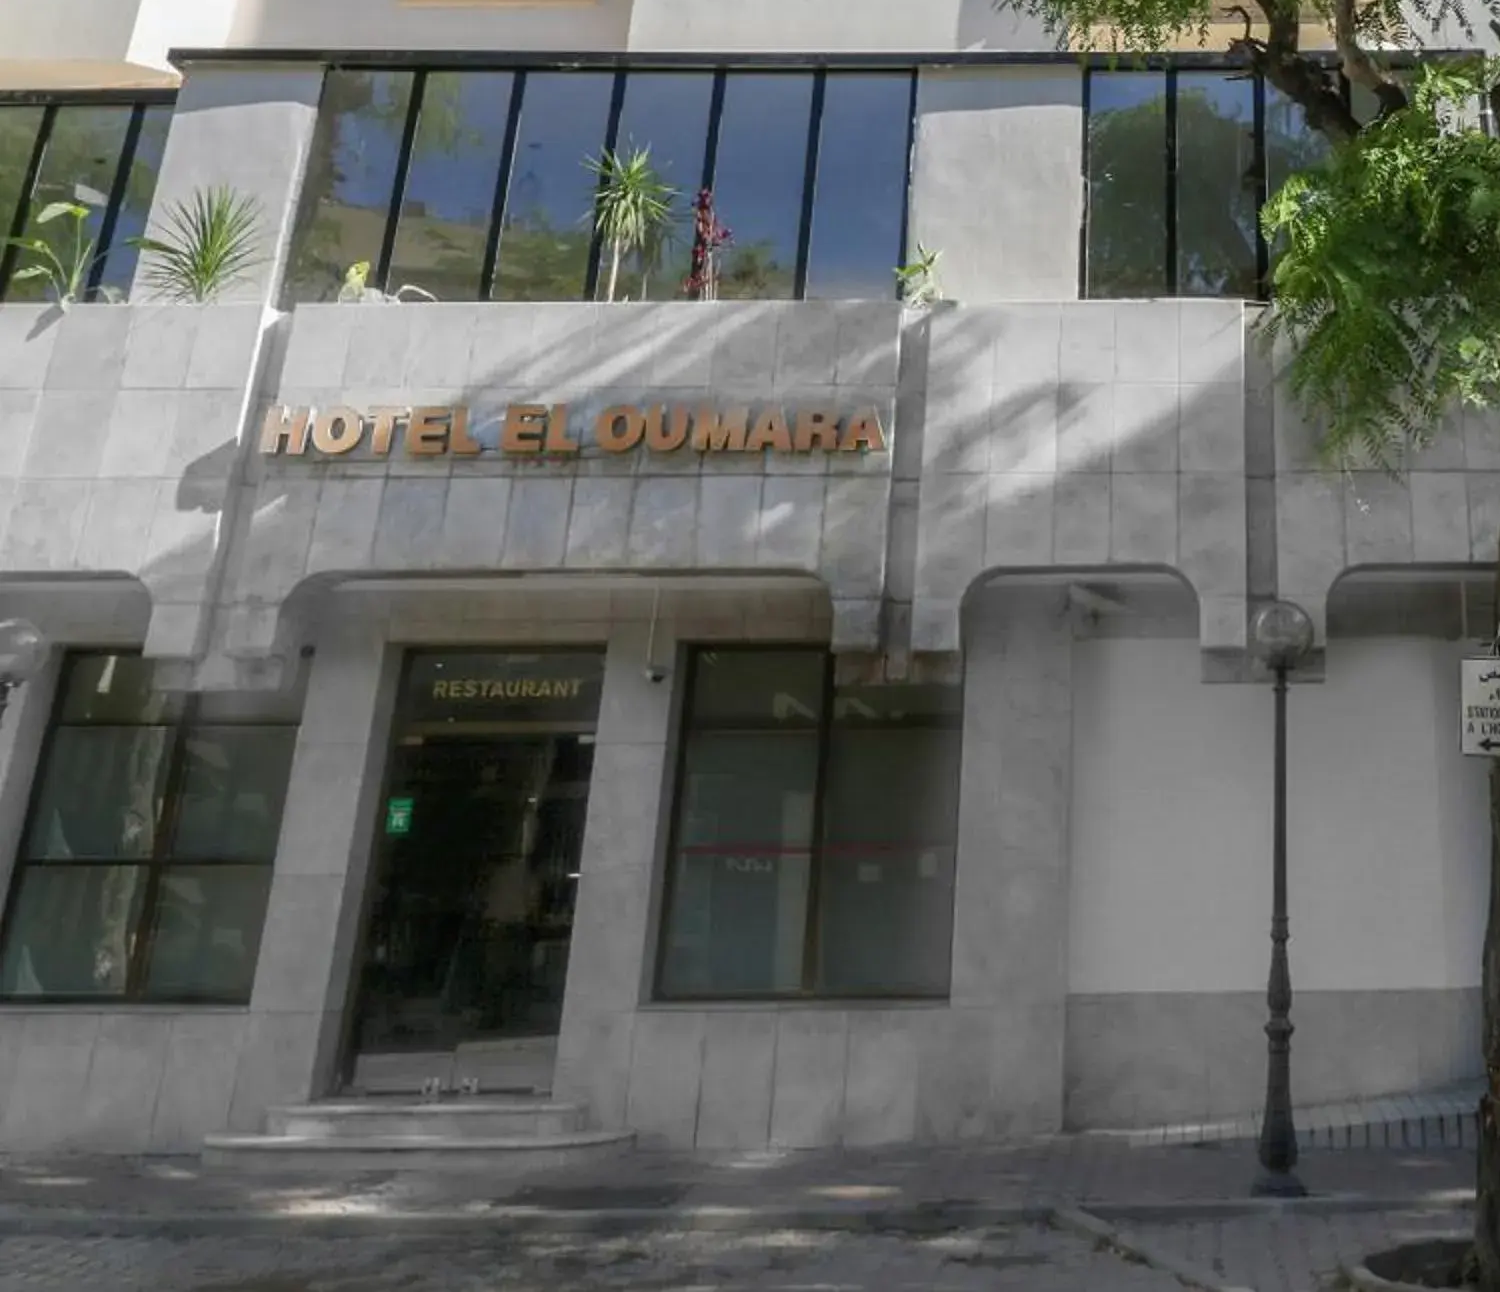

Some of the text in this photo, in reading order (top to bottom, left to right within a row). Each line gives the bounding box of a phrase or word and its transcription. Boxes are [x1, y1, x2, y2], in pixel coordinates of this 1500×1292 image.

[260, 401, 889, 456] HOTEL EL OUMARA
[432, 678, 583, 698] RESTAURANT
